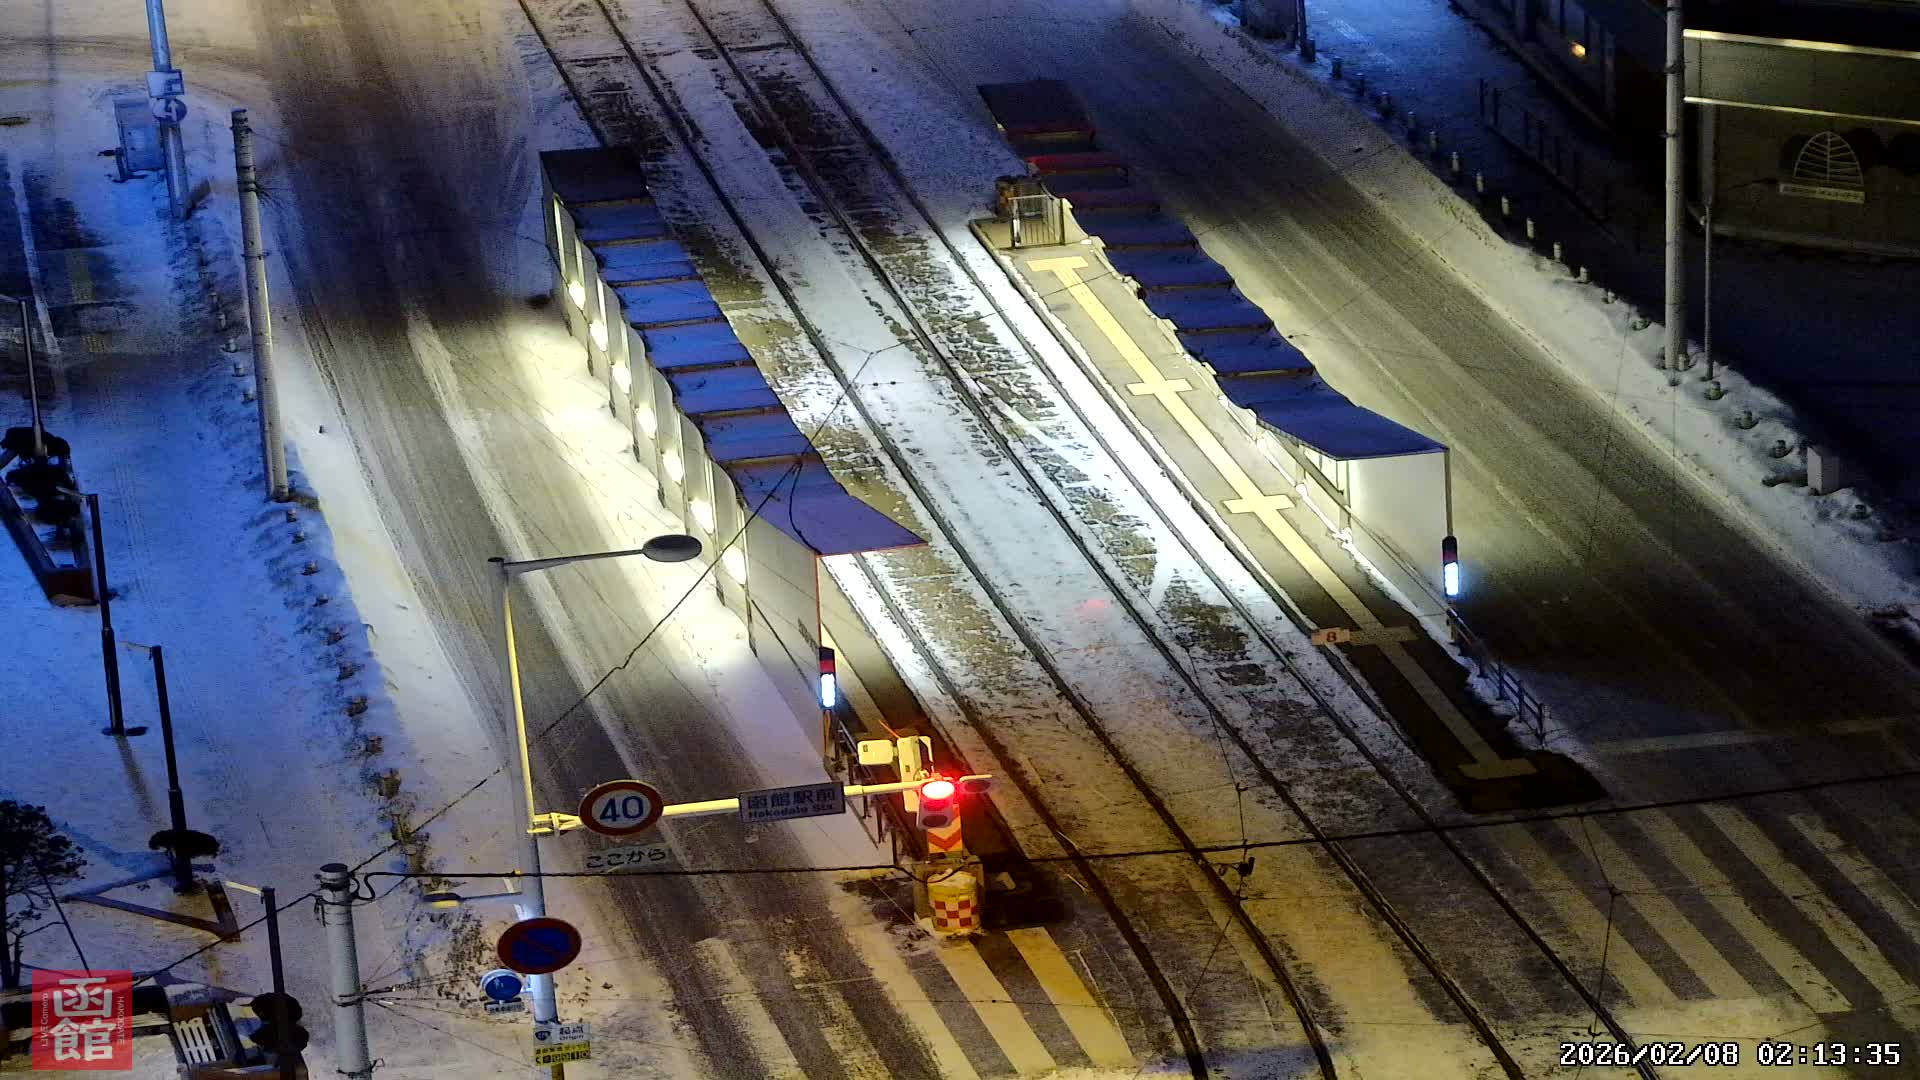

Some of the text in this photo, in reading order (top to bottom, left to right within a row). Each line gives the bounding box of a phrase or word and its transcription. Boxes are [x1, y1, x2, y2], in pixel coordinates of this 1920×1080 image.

[747, 789, 836, 807] 函館駅前
[599, 795, 644, 822] 40
[748, 805, 809, 819] Hakodate
[587, 849, 665, 868] ここから
